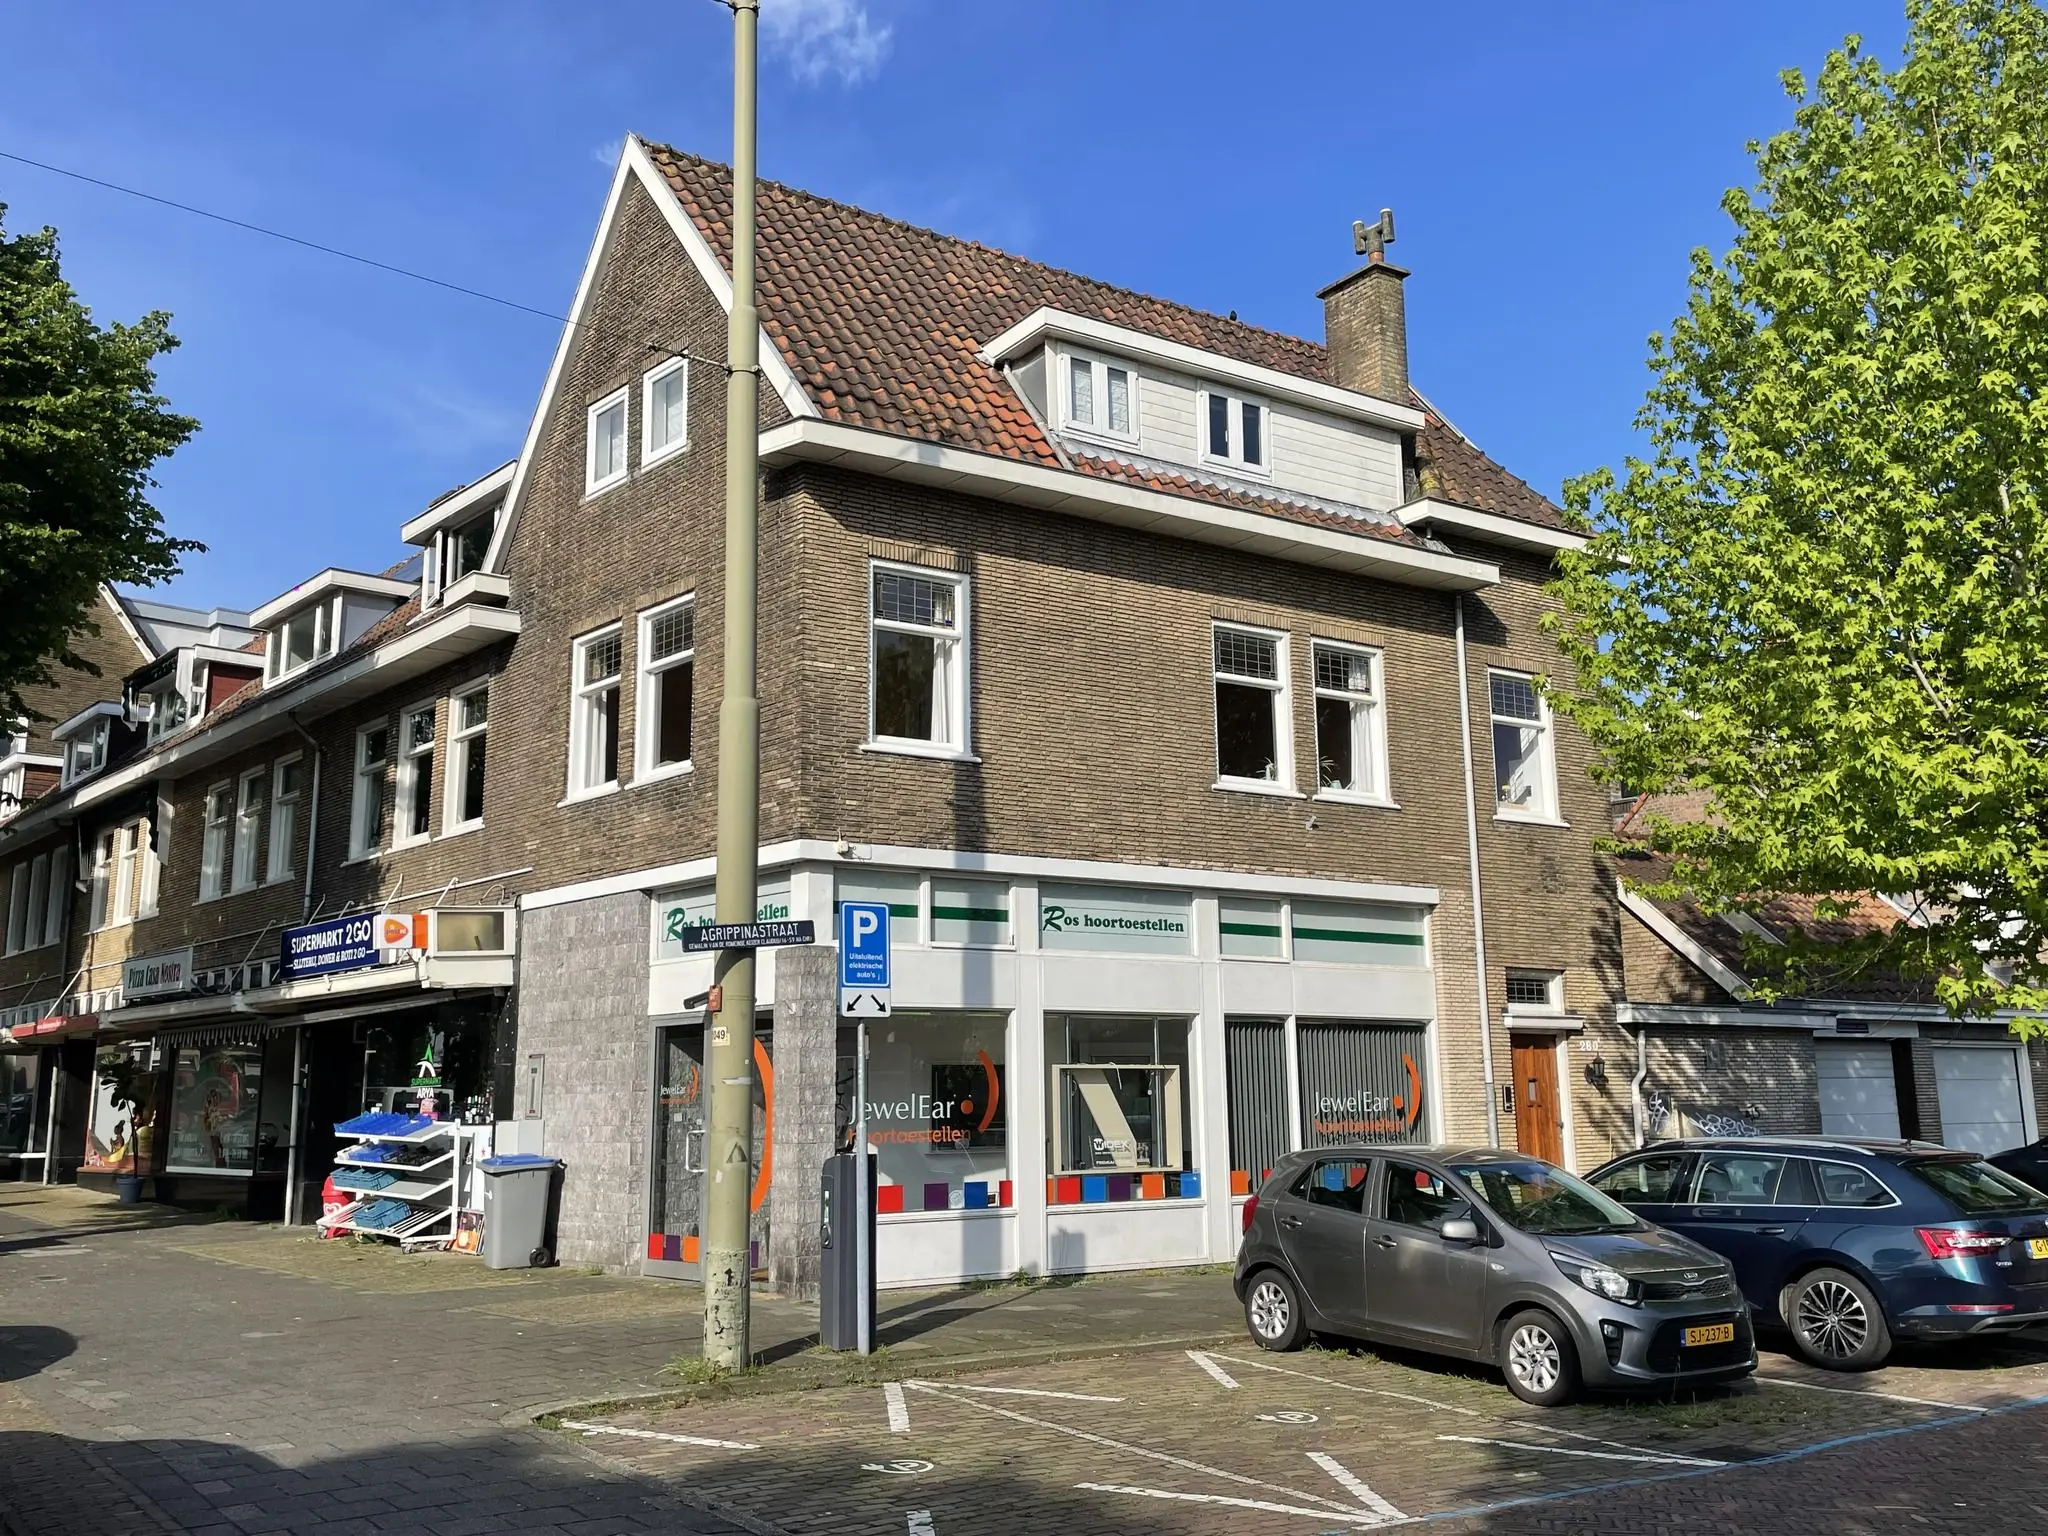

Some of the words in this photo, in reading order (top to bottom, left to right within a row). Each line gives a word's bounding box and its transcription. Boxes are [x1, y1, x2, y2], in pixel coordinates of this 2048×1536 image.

[1042, 905, 1080, 932] Ros
[1084, 914, 1184, 932] hoortoestellen
[701, 923, 798, 942] AGRIPPINASTRAAT
[853, 910, 878, 948] P
[291, 928, 344, 954] SUPERMARKT
[336, 951, 341, 962] &
[849, 952, 883, 961] Uitsluitend
[128, 967, 145, 989] Pizza
[145, 964, 160, 986] Casa
[160, 960, 181, 983] Nostra
[849, 962, 883, 970] elektrische
[411, 1076, 442, 1086] SUPERMARKT
[660, 1084, 687, 1096] JewelEar
[416, 1087, 435, 1099] ARYA
[848, 1092, 955, 1125] JewelEar
[1314, 1090, 1389, 1117] JewelEar
[1690, 1326, 1730, 1343] SJ-237-B
